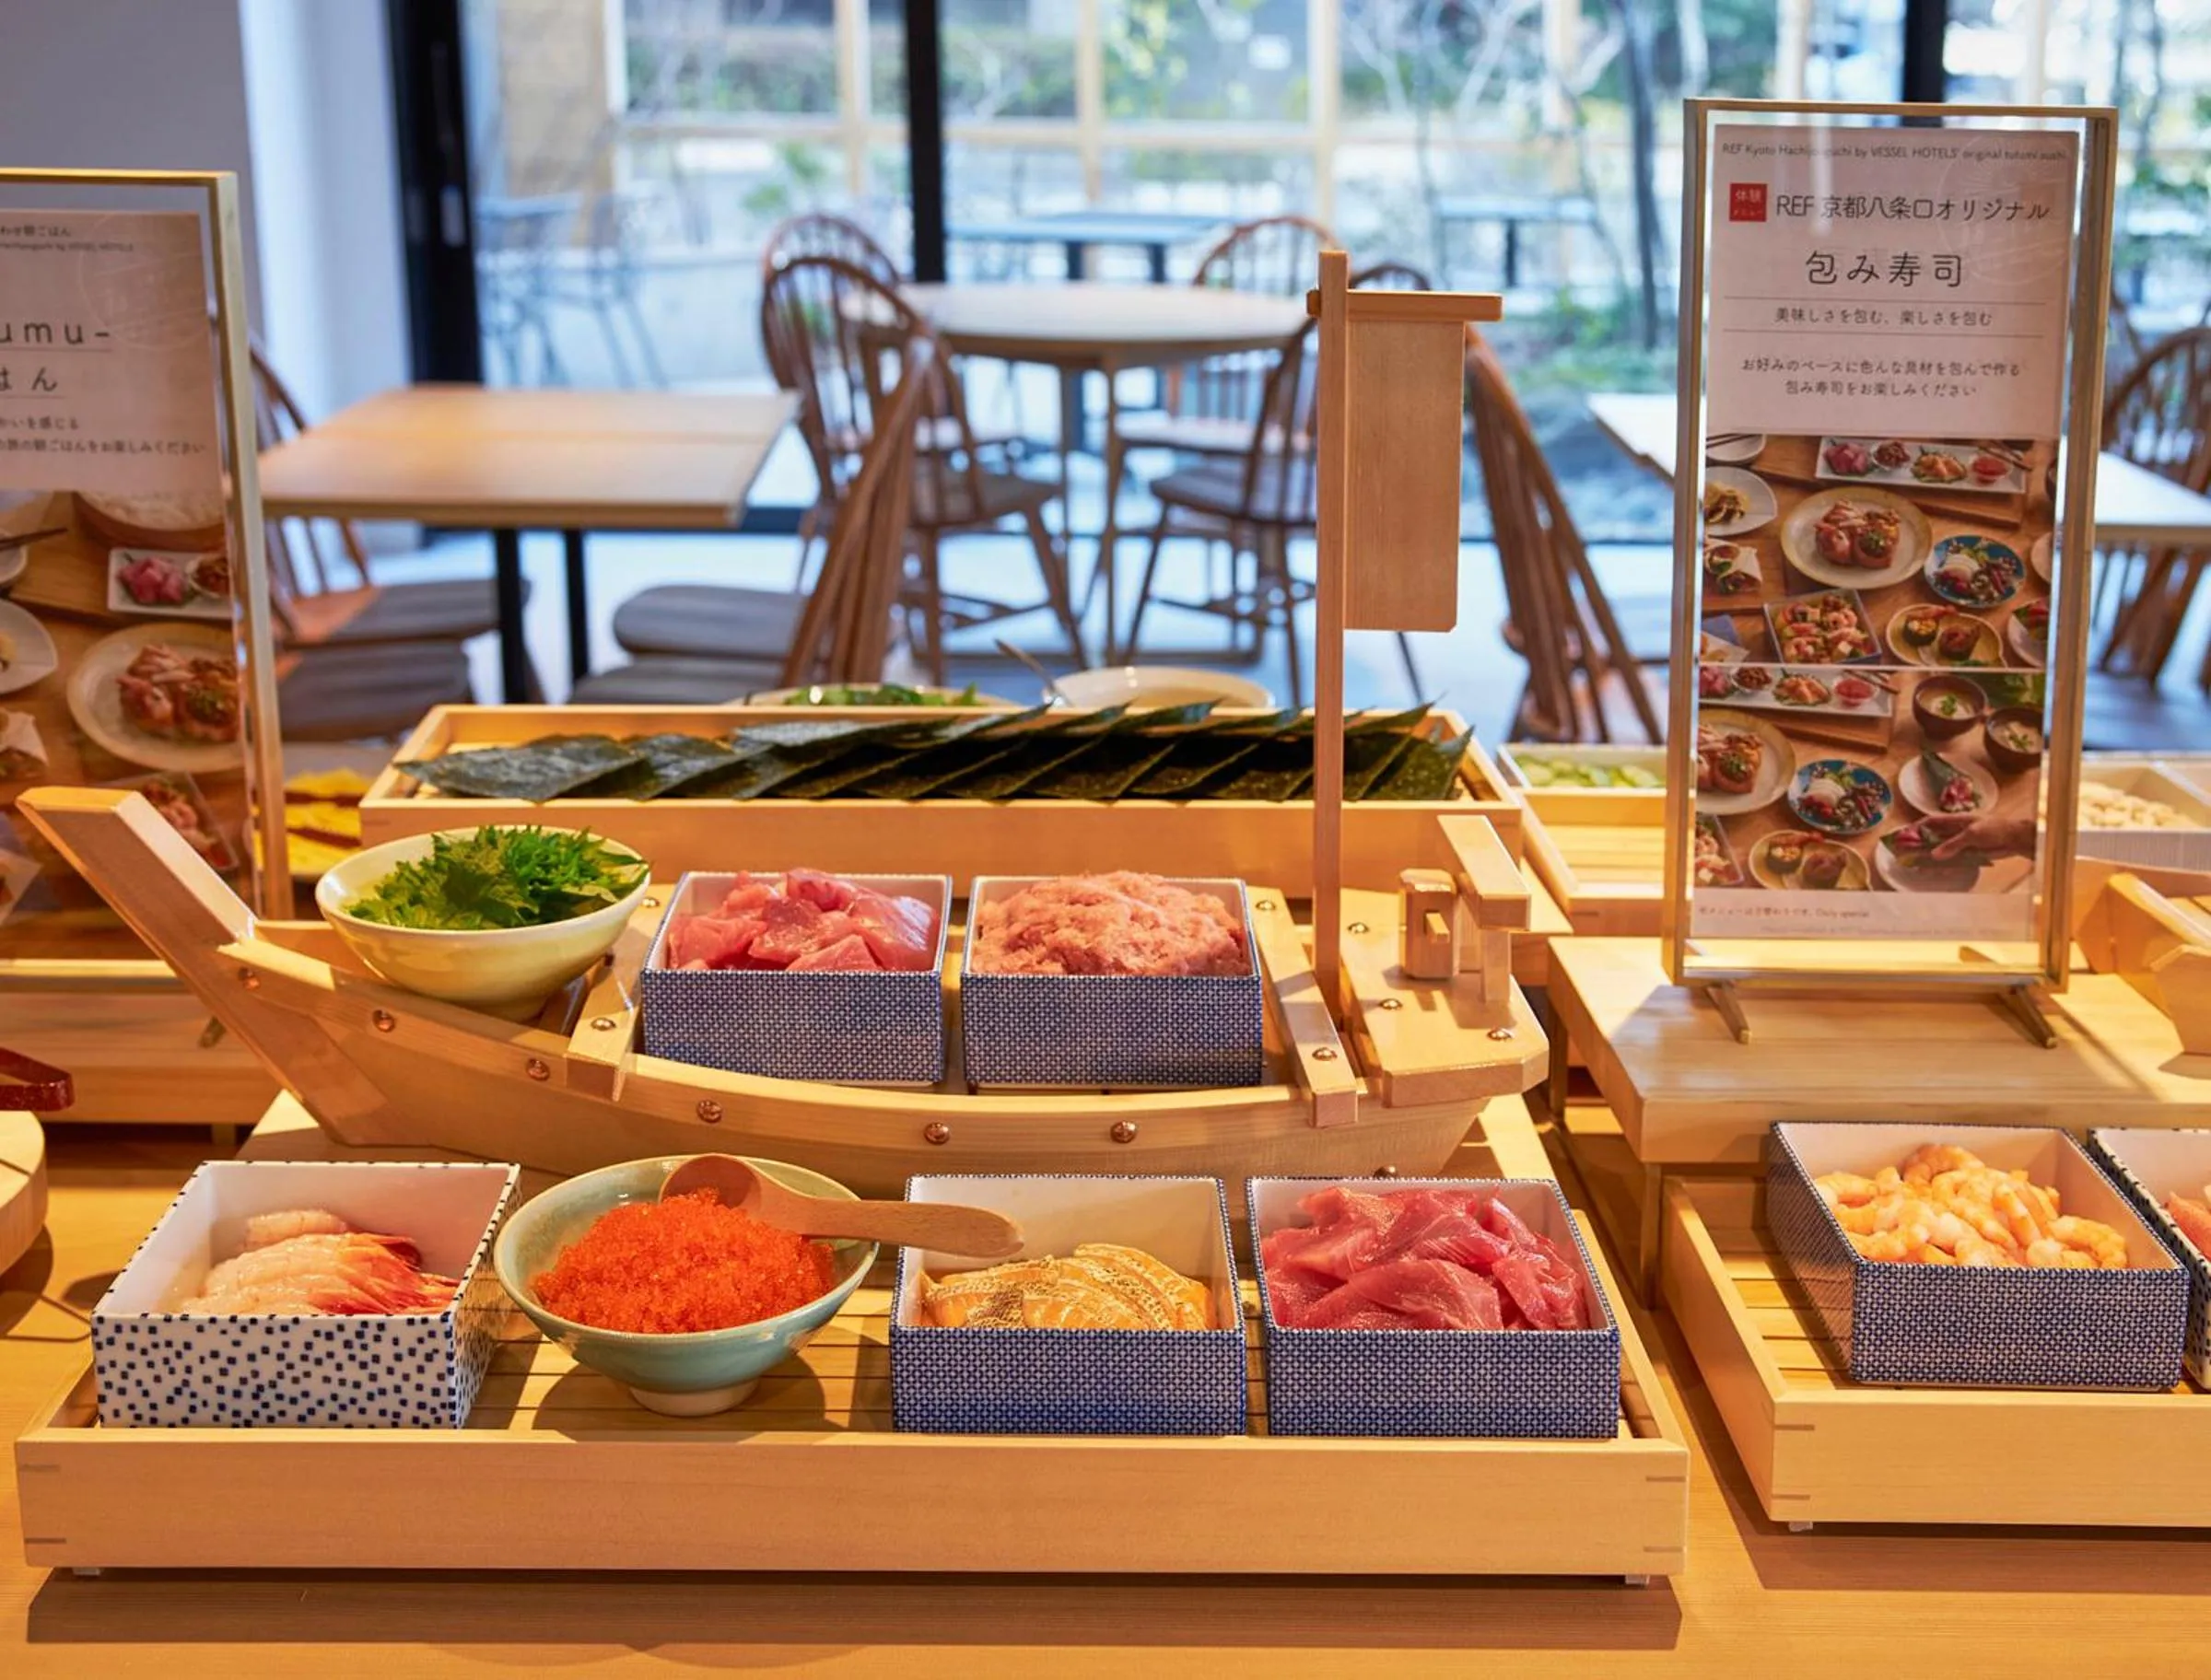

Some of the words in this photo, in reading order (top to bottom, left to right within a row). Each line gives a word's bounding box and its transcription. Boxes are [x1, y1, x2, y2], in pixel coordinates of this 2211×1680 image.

[1722, 143, 1743, 155] REF
[1745, 144, 1776, 158] Kyoto
[1854, 147, 1867, 159] by
[1871, 146, 1907, 158] VESSEL
[1776, 195, 1814, 216] REF
[1820, 195, 2050, 221] 京都八条口オリジナル
[1806, 251, 1962, 287] 包み寿司
